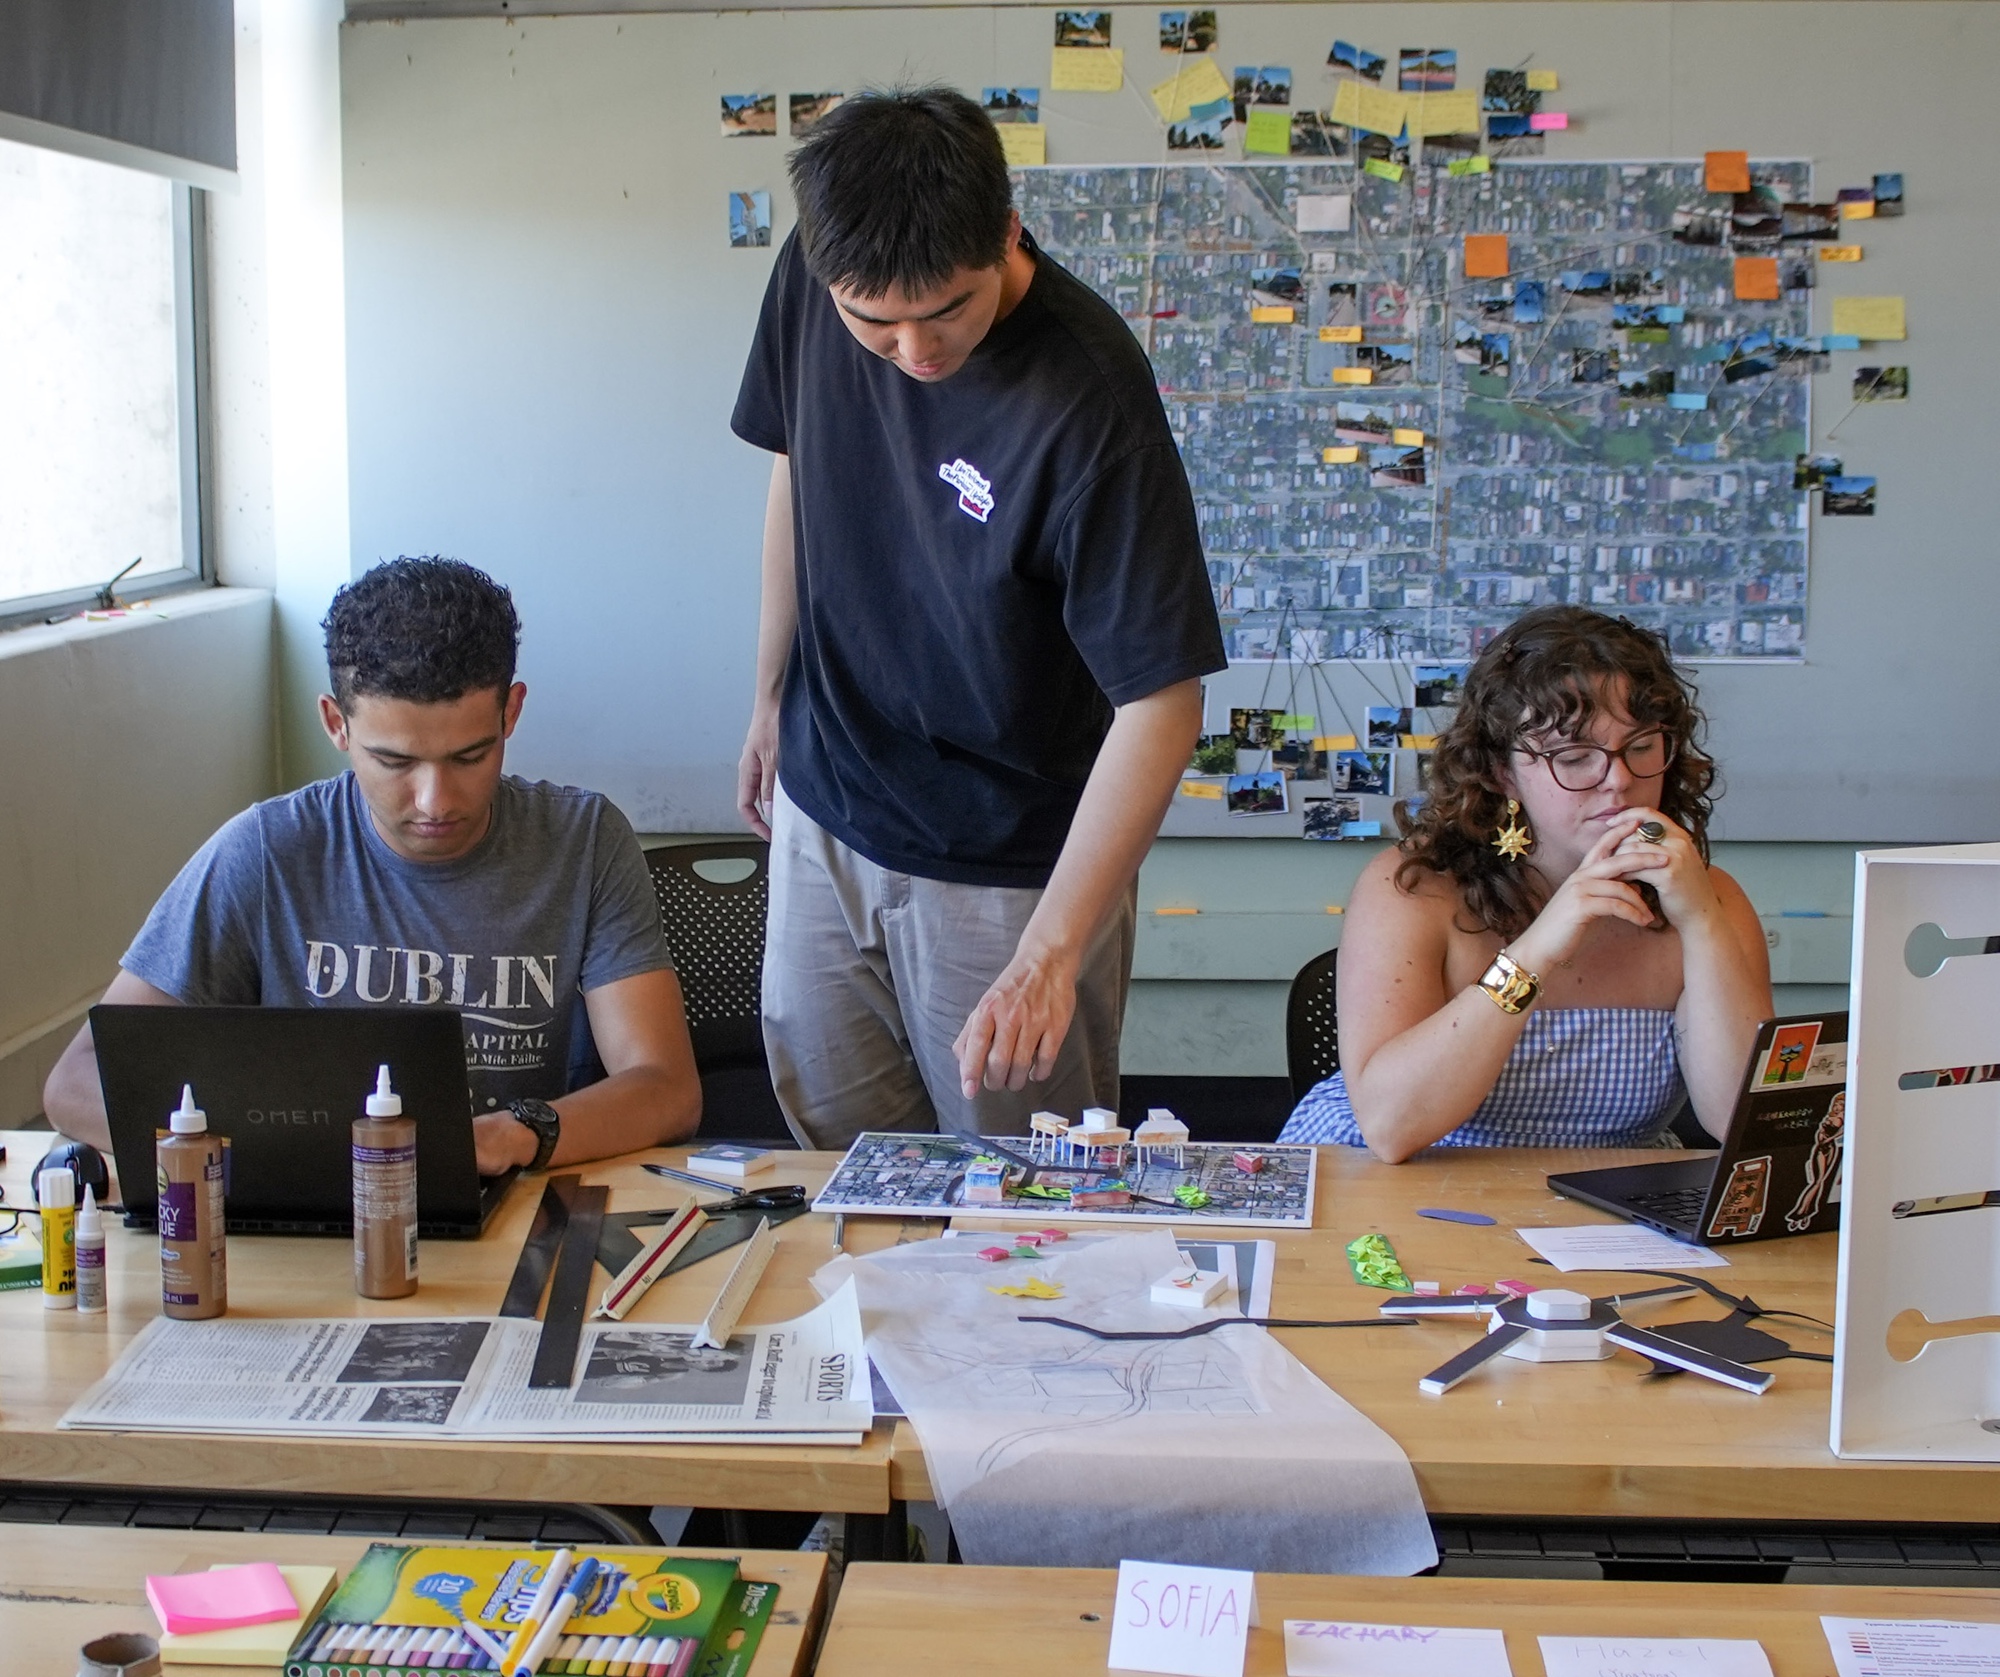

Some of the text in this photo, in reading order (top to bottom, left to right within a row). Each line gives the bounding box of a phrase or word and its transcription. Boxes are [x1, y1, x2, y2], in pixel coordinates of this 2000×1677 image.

[305, 940, 558, 1009] DUBLIN
[465, 1032, 549, 1051] APITAL
[247, 1109, 330, 1125] OMEN
[159, 1204, 180, 1222] CKY
[816, 1353, 845, 1402] SPORTS
[437, 1578, 464, 1594] 20
[665, 1580, 683, 1612] Crayola
[1128, 1580, 1241, 1639] SOFIA
[1294, 1622, 1439, 1644] ZACHARY
[1575, 1643, 1707, 1661] Hazel
